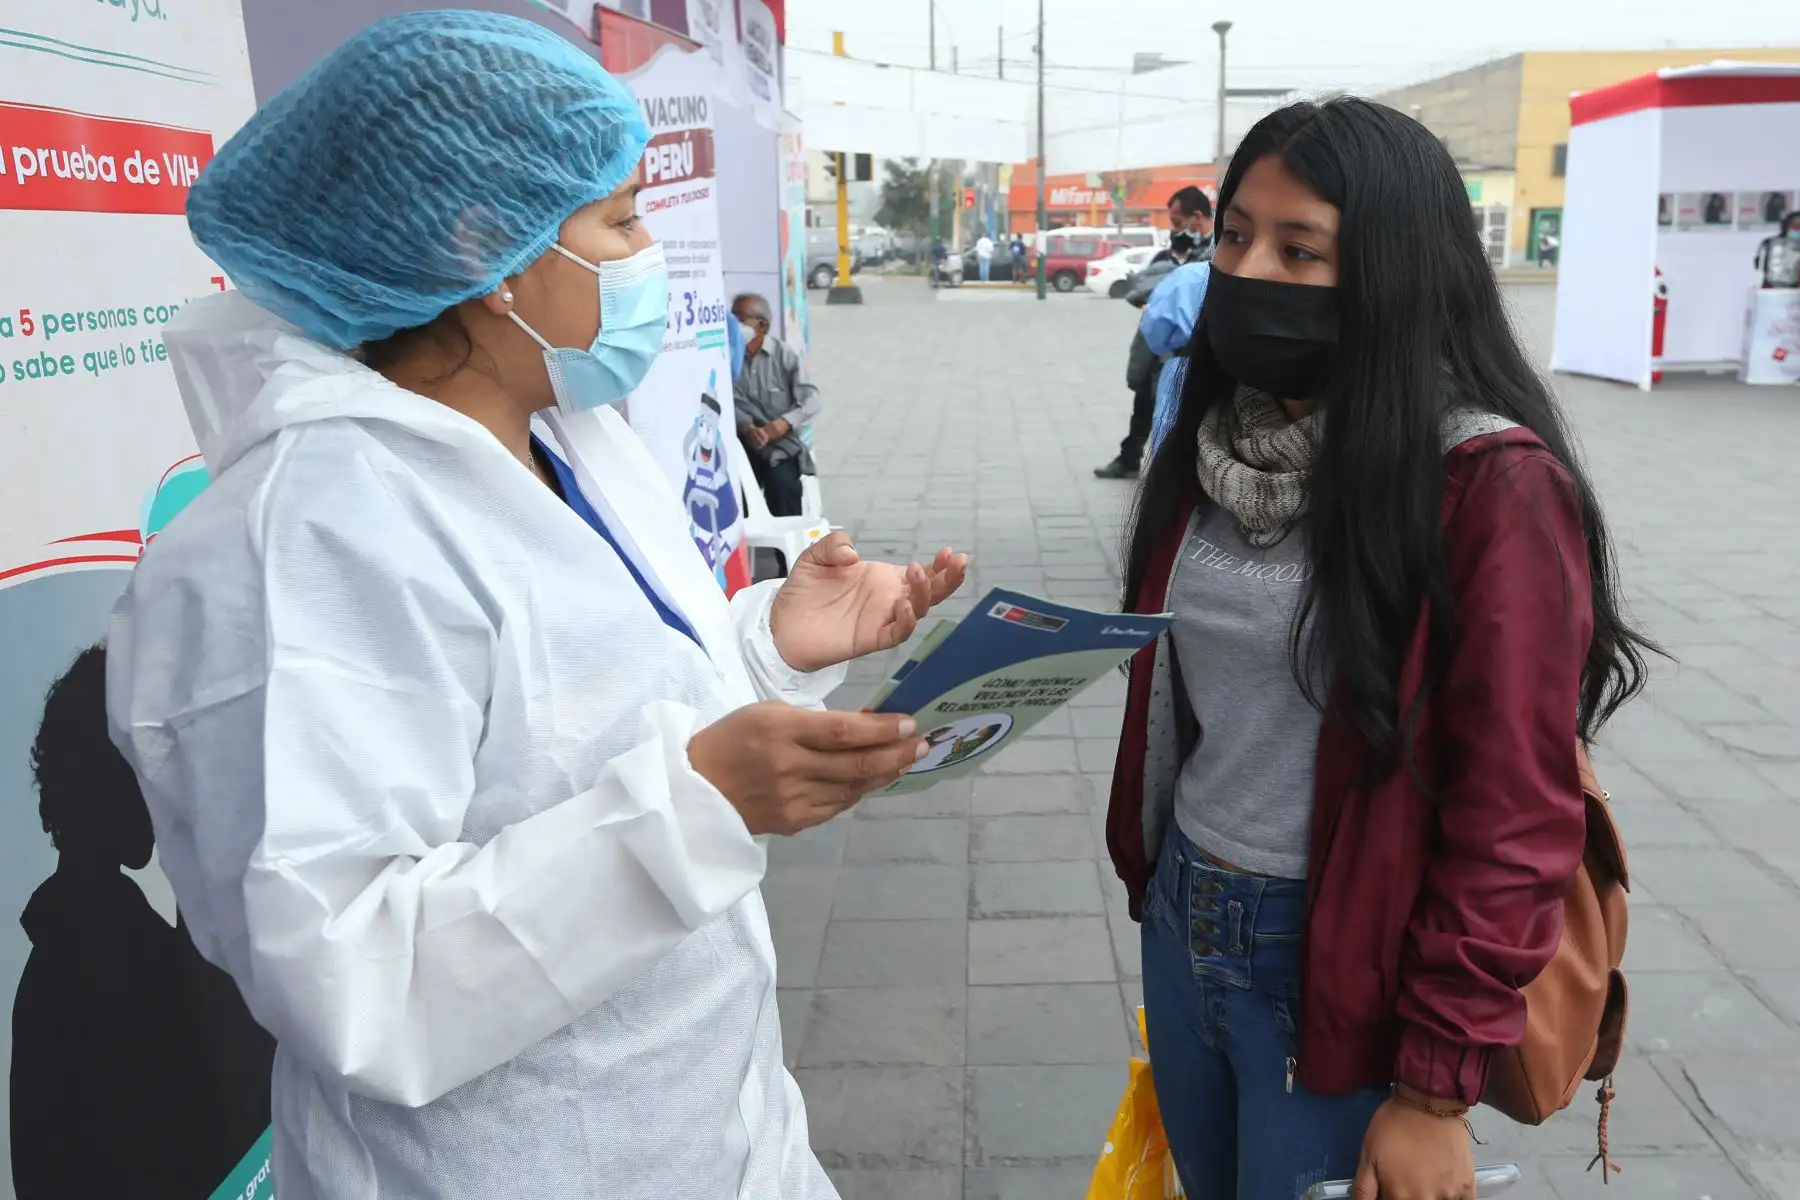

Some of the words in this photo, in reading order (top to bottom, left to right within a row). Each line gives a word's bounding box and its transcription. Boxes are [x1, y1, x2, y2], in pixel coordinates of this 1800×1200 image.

[644, 95, 708, 127] VACUNO
[12, 145, 118, 184] prueba
[123, 150, 160, 185] de
[162, 152, 199, 187] VIH
[645, 131, 694, 184] PERÚ
[0, 316, 14, 338] a
[19, 309, 35, 337] 5
[42, 307, 138, 341] personas
[674, 310, 682, 334] y
[698, 299, 726, 325] dosis
[12, 351, 75, 381] sabe
[83, 348, 118, 377] que
[119, 343, 136, 367] lo
[1189, 539, 1241, 570] THE
